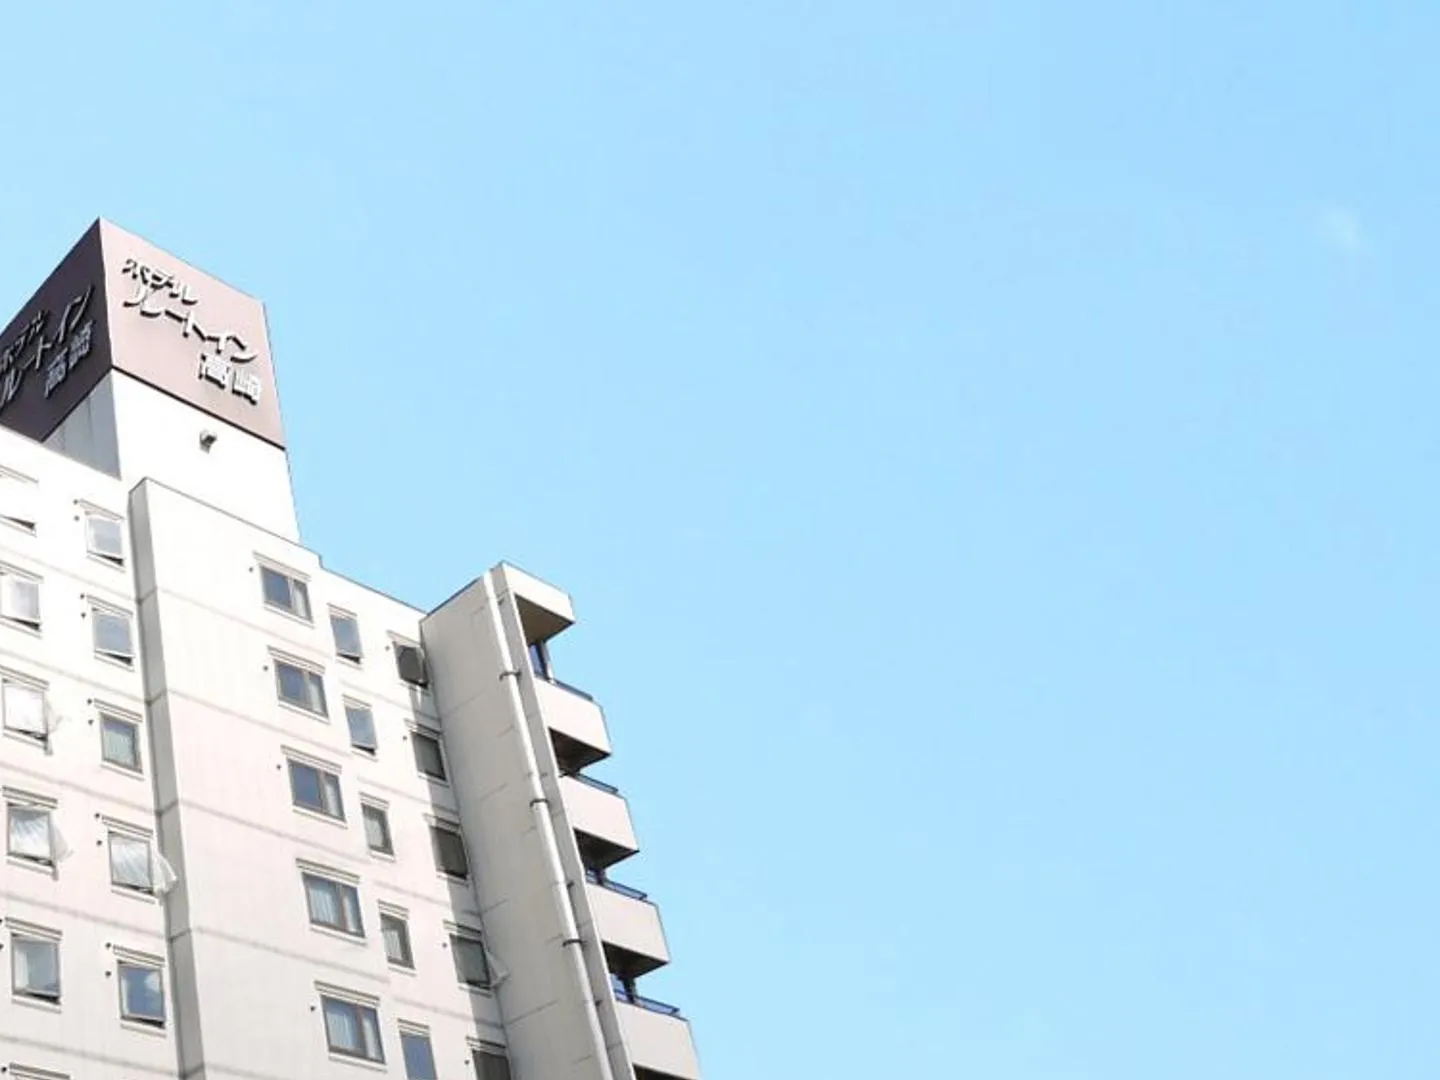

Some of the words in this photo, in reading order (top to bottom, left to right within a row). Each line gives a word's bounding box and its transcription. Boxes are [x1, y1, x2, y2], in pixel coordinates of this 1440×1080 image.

[123, 258, 198, 305] ホテル
[123, 285, 257, 363] ルートイン
